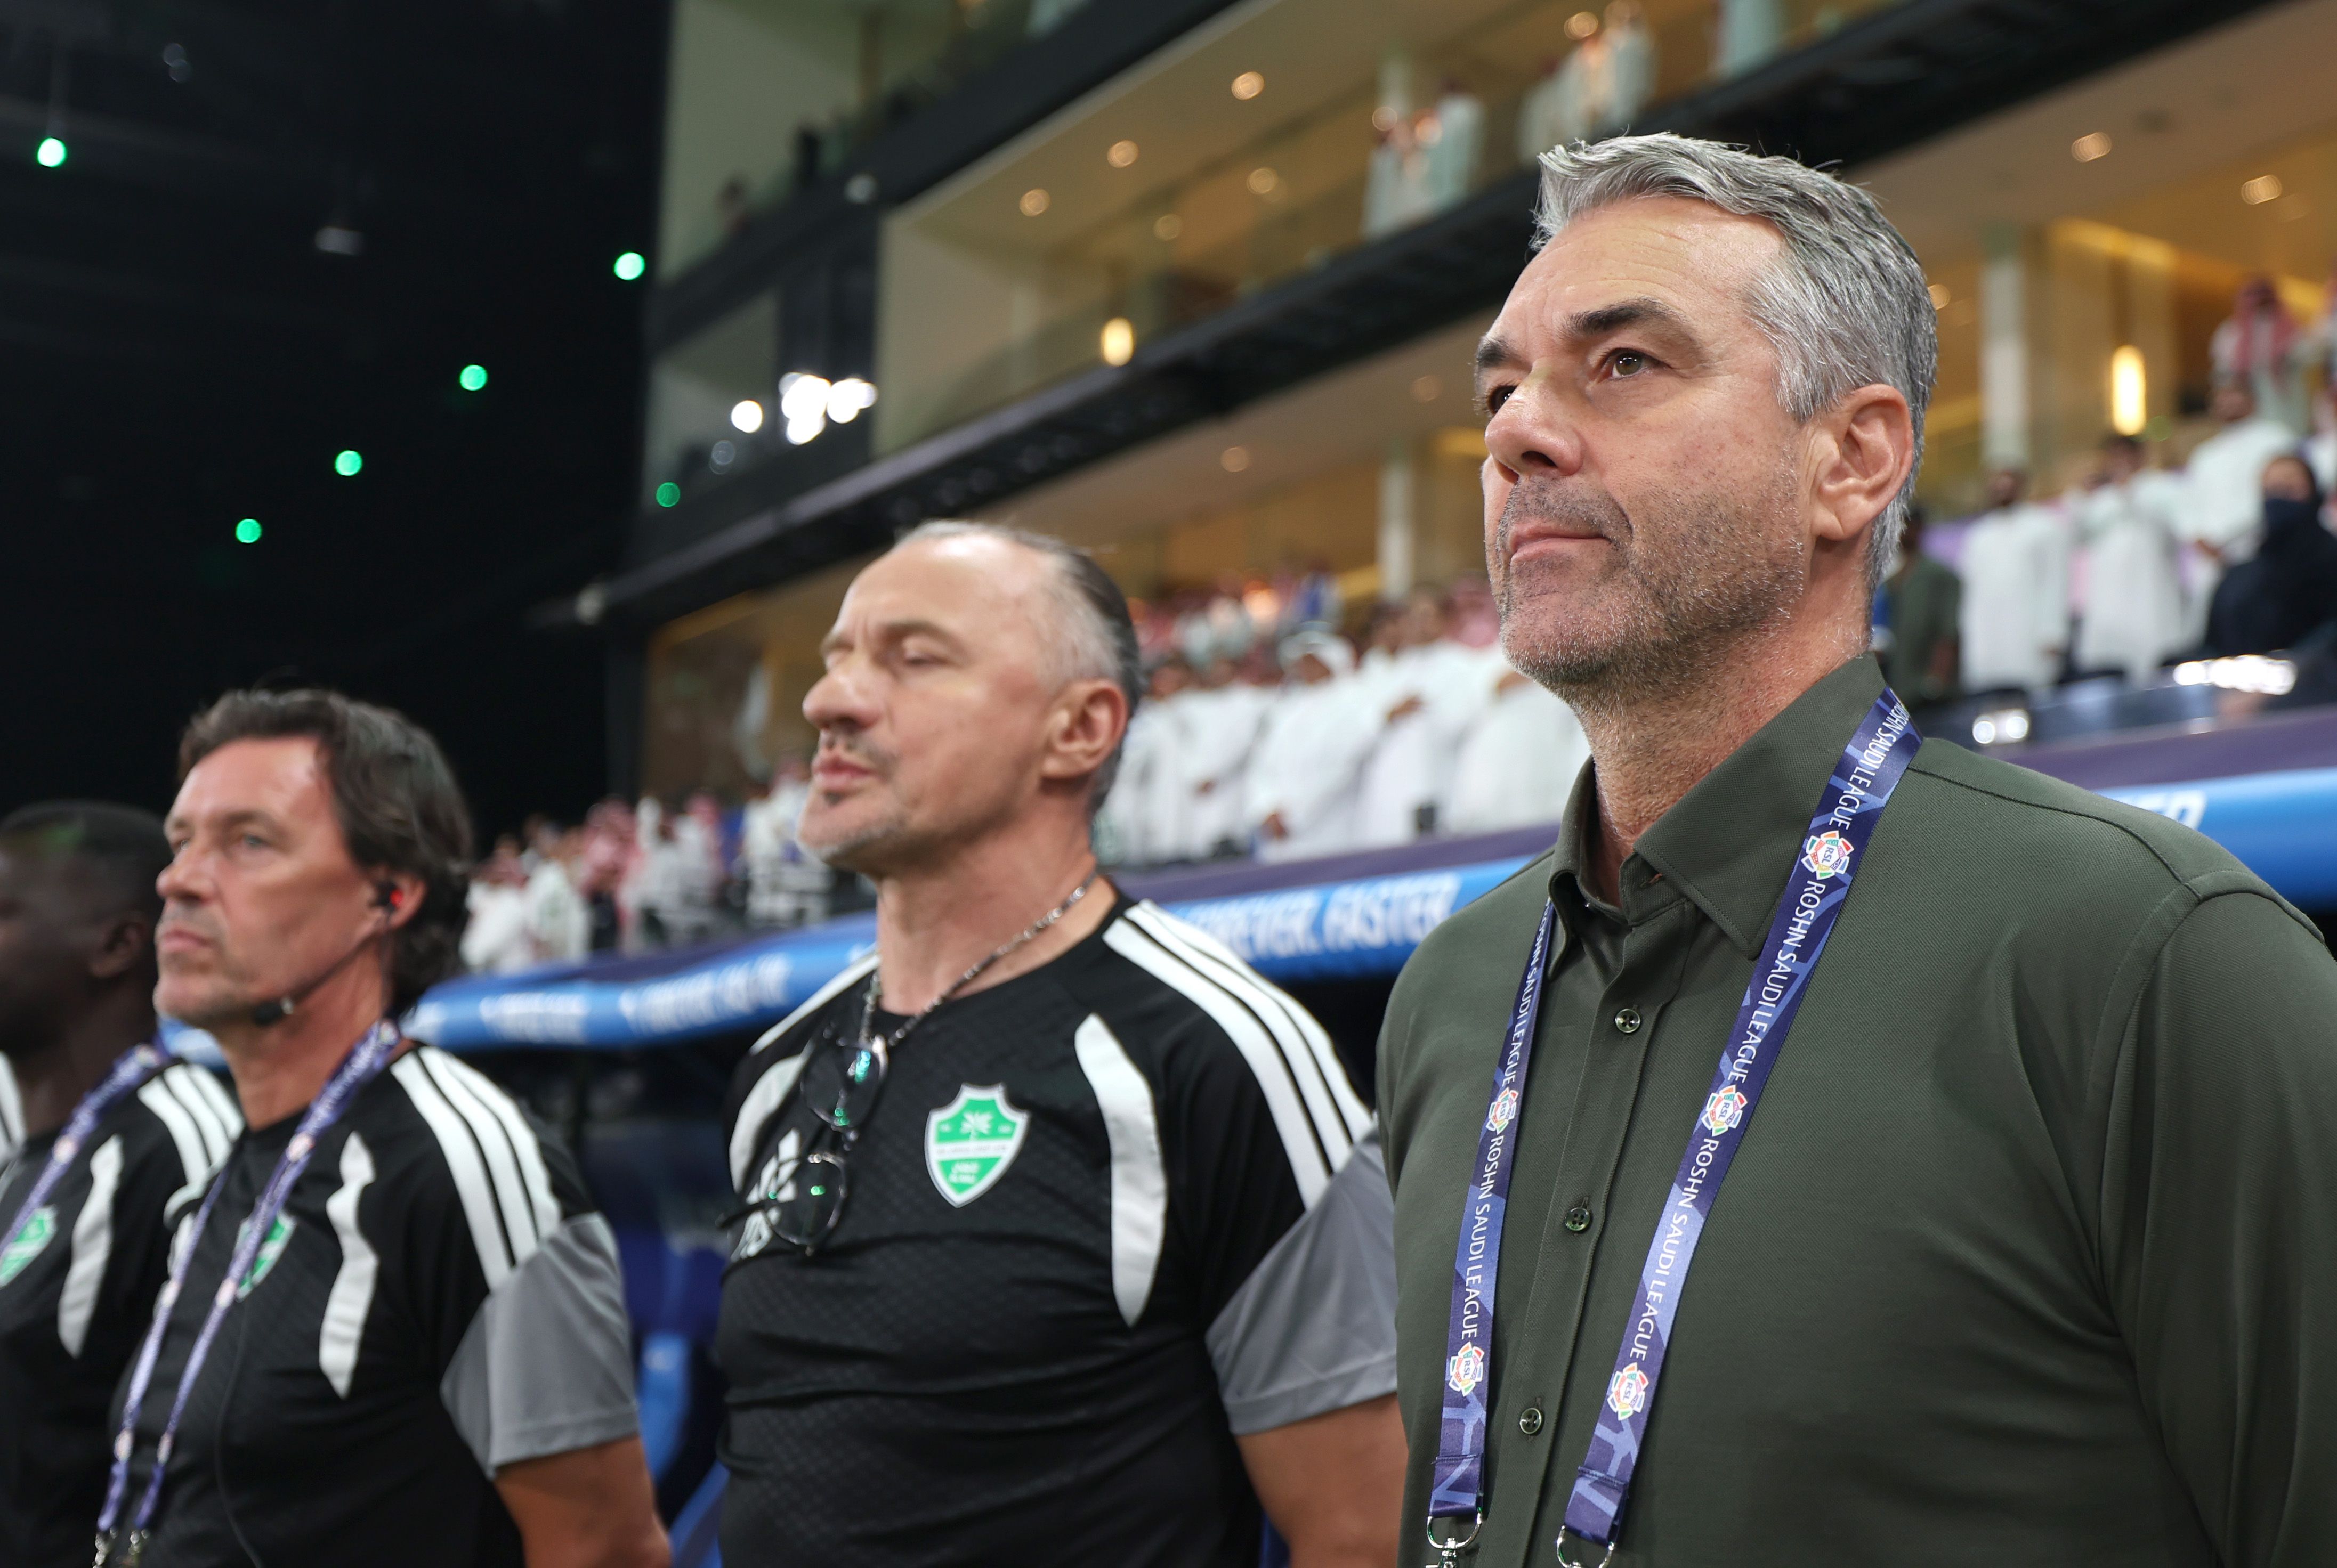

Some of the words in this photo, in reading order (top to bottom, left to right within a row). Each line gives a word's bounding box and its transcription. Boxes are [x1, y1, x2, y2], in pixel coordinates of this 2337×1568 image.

[1860, 727, 1897, 770] SAUDI
[1829, 766, 1877, 830] LEAGUE
[1821, 846, 1834, 864] RSL
[1783, 880, 1826, 948] ROSHN
[1517, 966, 1538, 1020] SAUDI
[1758, 949, 1797, 1008] SAUDI
[1502, 1019, 1526, 1087] LEAGUE
[1727, 1010, 1772, 1083] LEAGUE
[1499, 1103, 1507, 1118] RSL
[1718, 1101, 1730, 1119] RSL
[1478, 1135, 1505, 1200] ROSHN
[1678, 1138, 1719, 1208] ROSHN
[1468, 1203, 1490, 1261] SAUDI
[1655, 1212, 1688, 1276] SAUDI
[1461, 1264, 1482, 1340] LEAGUE
[1630, 1279, 1666, 1361] LEAGUE
[1462, 1360, 1471, 1377] RSL
[1622, 1382, 1634, 1400] RSL
